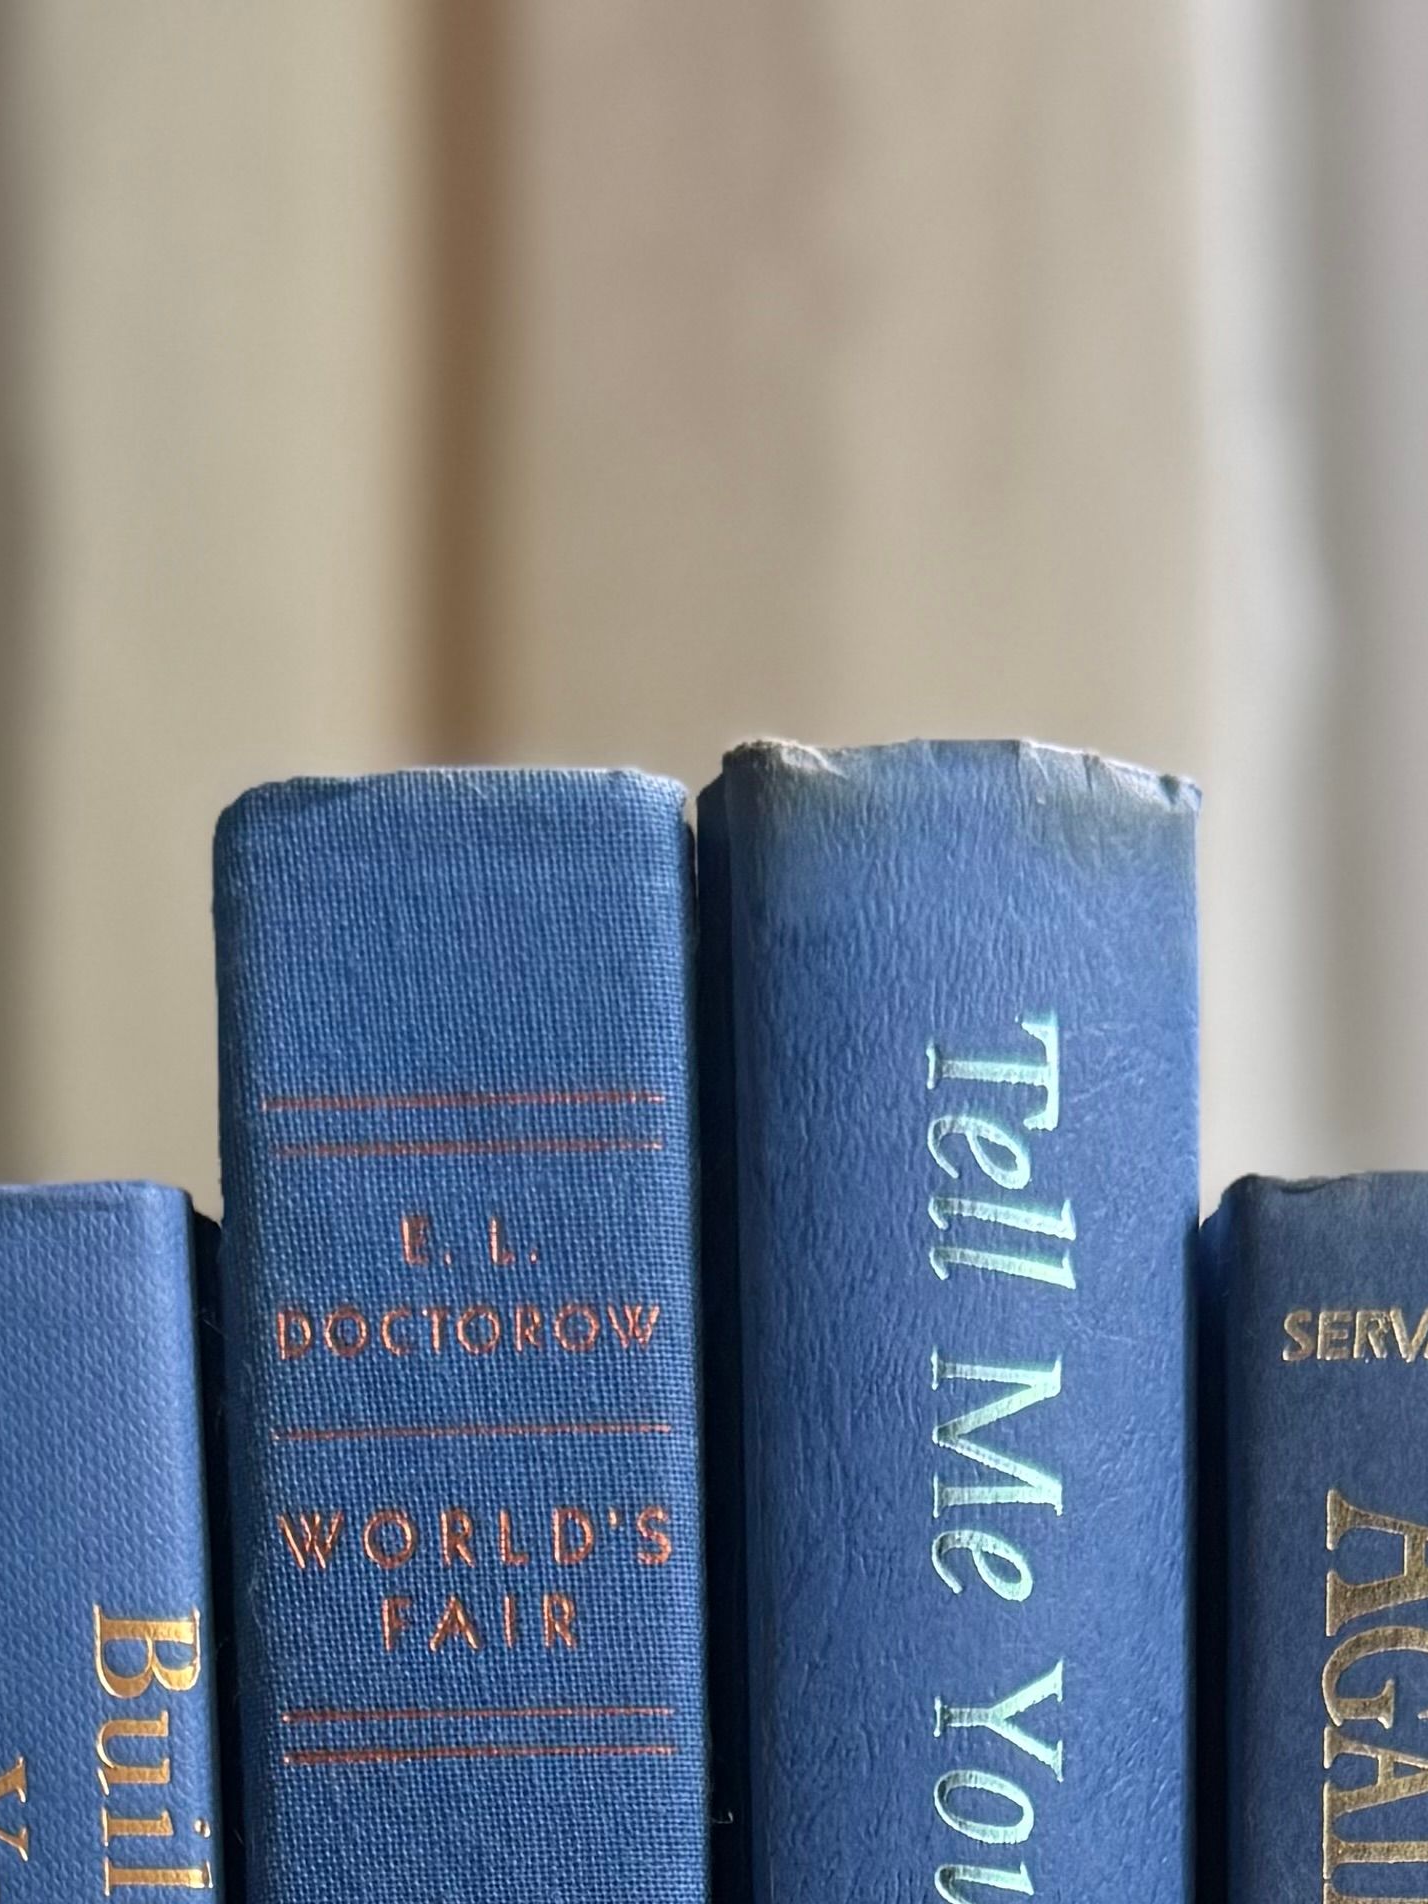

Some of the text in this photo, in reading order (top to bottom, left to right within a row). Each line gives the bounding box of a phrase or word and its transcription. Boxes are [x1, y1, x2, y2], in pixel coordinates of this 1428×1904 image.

[925, 1009, 1077, 1290] Tell
[400, 1213, 541, 1267] E. L.
[272, 1300, 664, 1364] DOCTOROW
[930, 1347, 1064, 1603] Me
[274, 1504, 675, 1573] WORLD'S
[378, 1594, 580, 1655] FAIR
